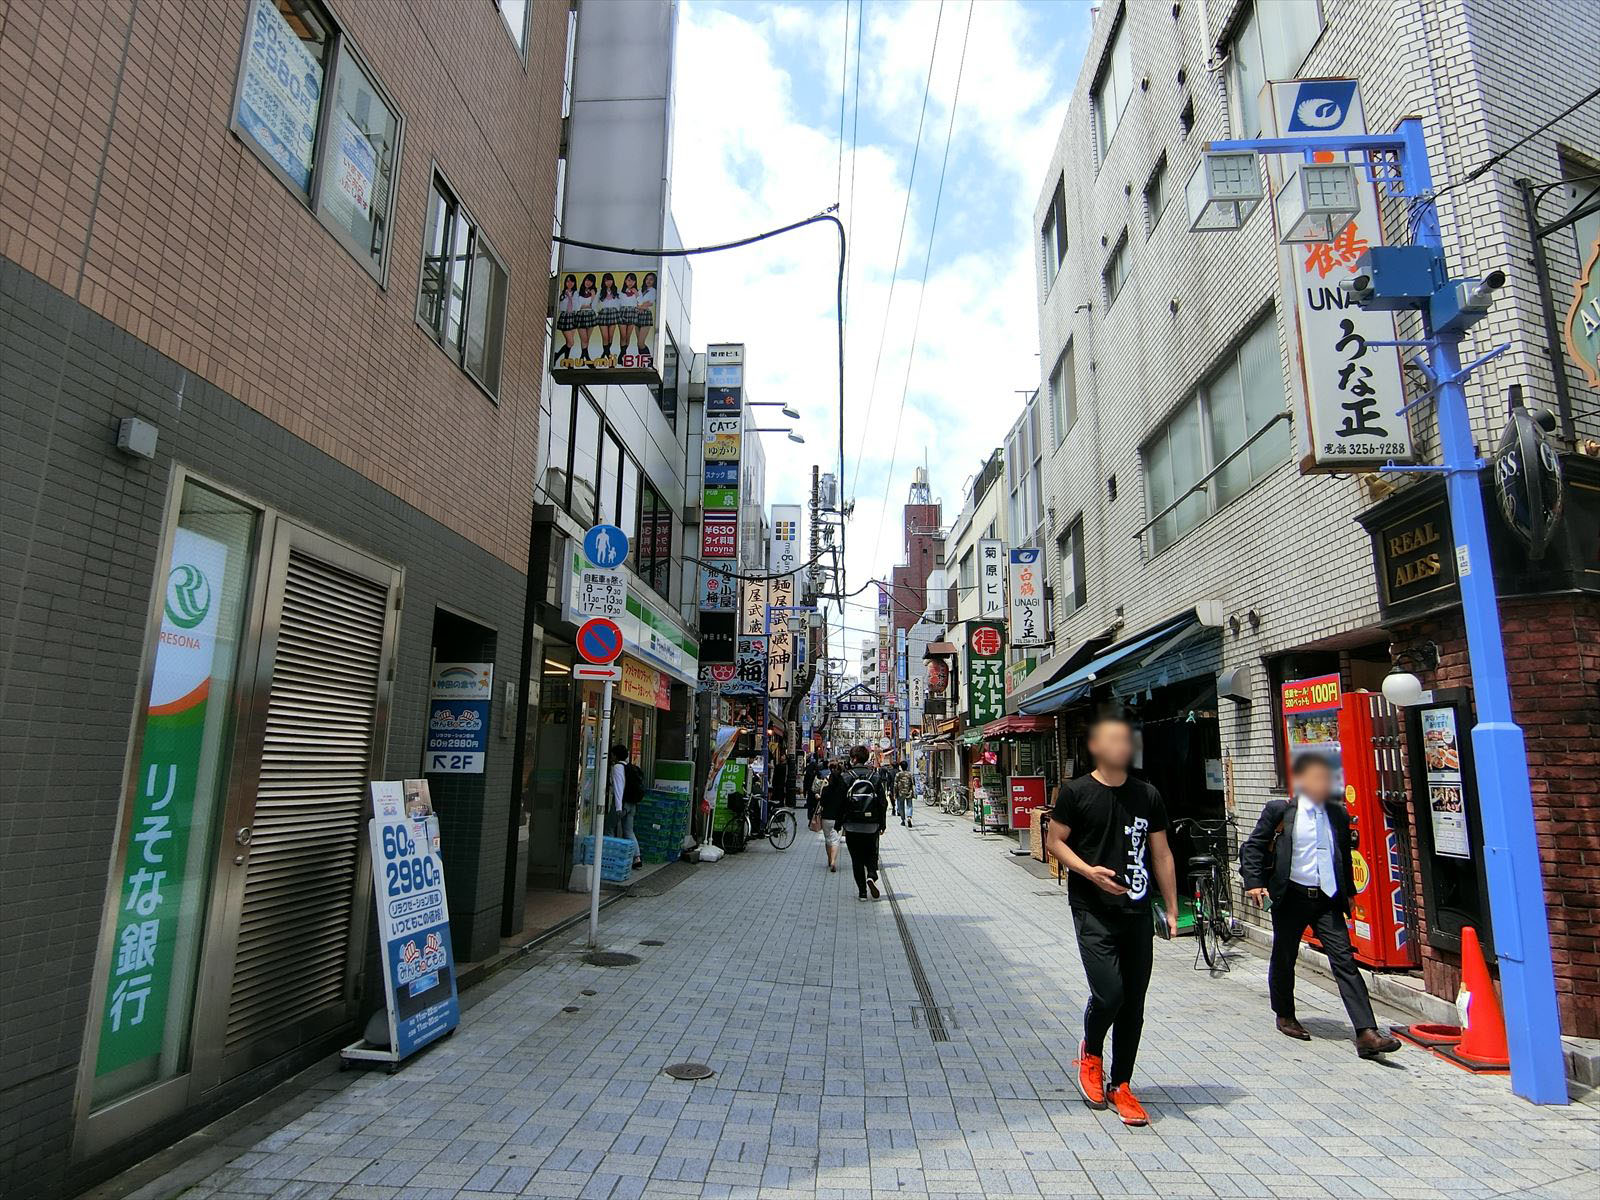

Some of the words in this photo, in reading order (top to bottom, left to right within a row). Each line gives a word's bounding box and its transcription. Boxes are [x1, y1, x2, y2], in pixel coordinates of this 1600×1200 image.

[623, 354, 652, 368] B1F
[1335, 318, 1389, 438] うな正
[710, 421, 738, 433] CATS
[708, 446, 737, 456] ゆかり
[1349, 442, 1405, 455] 3256-9288
[705, 471, 726, 480] スナック
[705, 525, 735, 535] ¥630
[705, 536, 734, 545] タイ料理
[1389, 522, 1440, 558] REAL
[704, 546, 734, 554] aroyna
[984, 546, 999, 612] 菊原ビル
[1395, 553, 1441, 588] ALES
[1014, 598, 1040, 607] UNAGI
[1021, 606, 1038, 639] うな正
[159, 631, 201, 650] RESONA
[974, 629, 1000, 655] 得
[971, 659, 987, 720] チケット
[986, 659, 1003, 719] マルトク
[1310, 682, 1338, 704] 100円
[450, 755, 473, 769] 2F
[383, 824, 415, 860] 60分
[386, 855, 441, 897] 2980円
[110, 762, 178, 1034] りそな銀行
